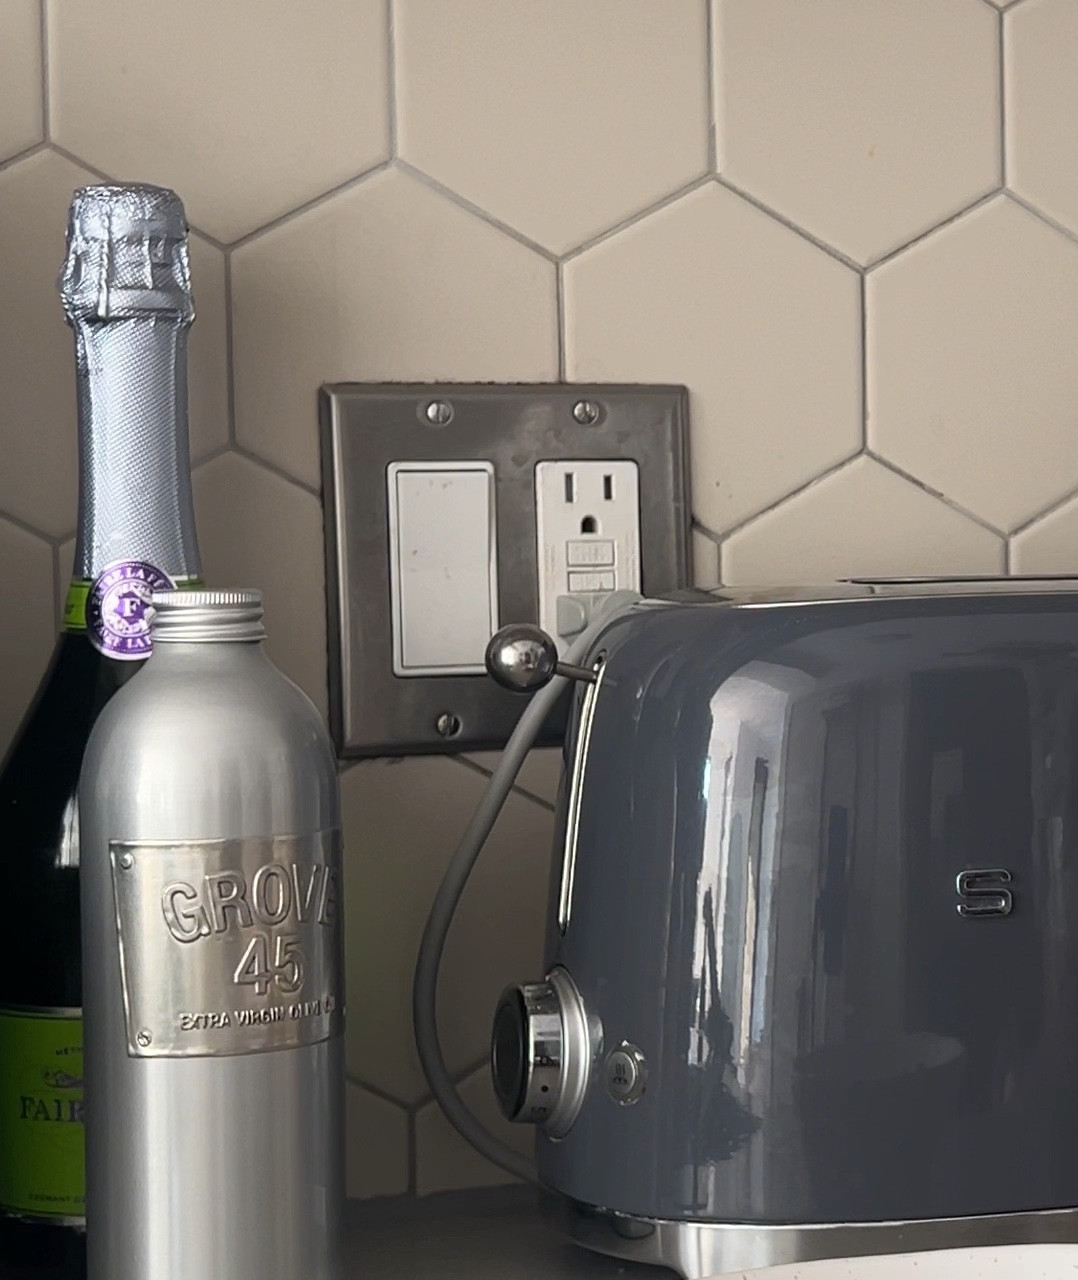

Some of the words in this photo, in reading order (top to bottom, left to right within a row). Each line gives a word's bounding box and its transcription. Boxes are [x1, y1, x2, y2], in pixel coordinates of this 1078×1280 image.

[122, 597, 141, 617] F
[233, 933, 304, 996] 45
[178, 1011, 231, 1031] EXTRA
[234, 1005, 286, 1027] VIRGIN
[20, 1095, 86, 1121] FAIR
